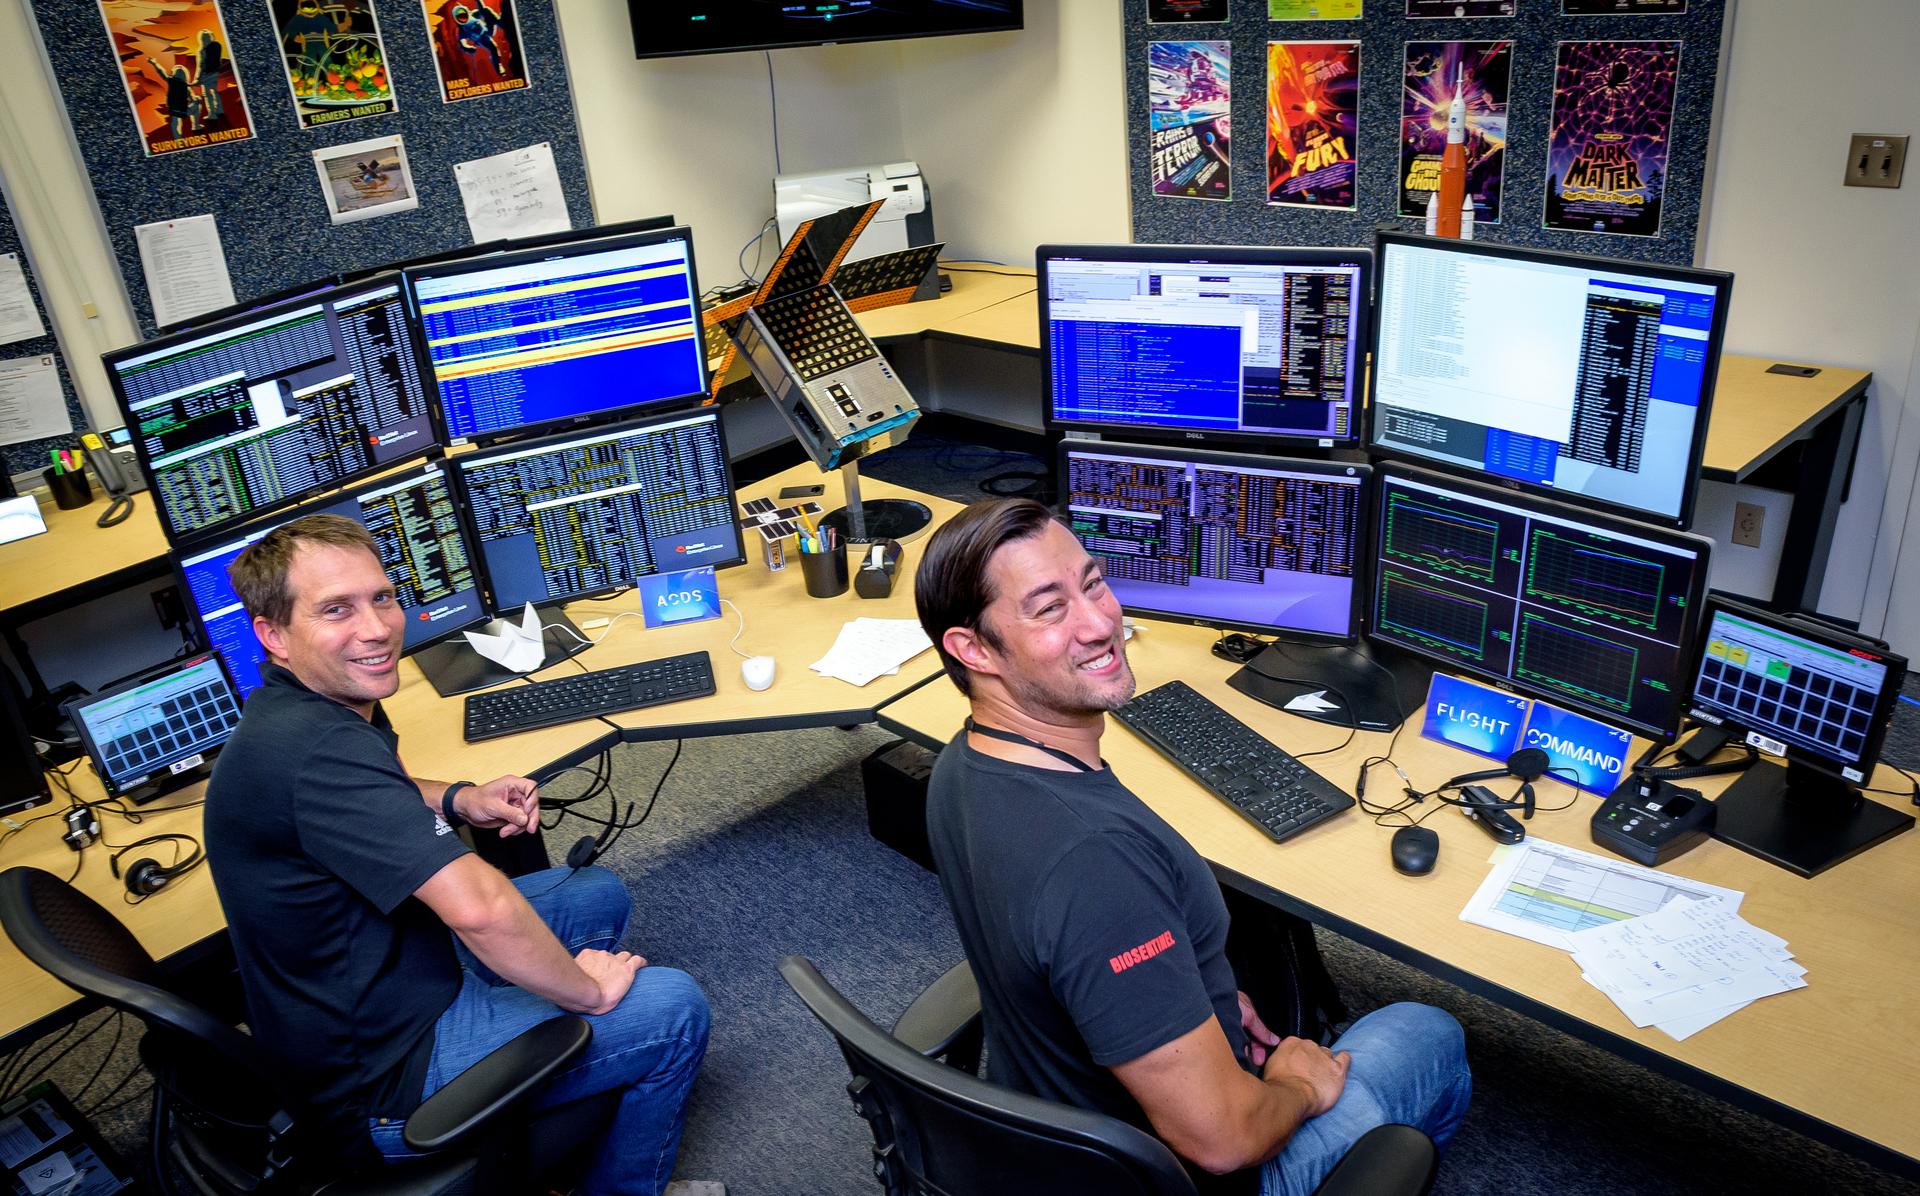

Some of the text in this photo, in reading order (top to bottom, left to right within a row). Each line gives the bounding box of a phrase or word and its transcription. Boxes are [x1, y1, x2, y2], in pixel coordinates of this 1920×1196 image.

[446, 78, 470, 90] MARS
[448, 78, 525, 100] EXPLORERS WANTED
[310, 102, 387, 125] FARMERS WANTED
[151, 127, 249, 153] SURVEYORS WANTED
[1291, 136, 1349, 178] FURY
[1583, 141, 1633, 165] DARK
[1562, 155, 1646, 193] MATTER
[1186, 432, 1205, 440] DELL
[657, 589, 703, 607] ACDS
[1496, 681, 1515, 692] DELL
[1436, 702, 1512, 737] FLIGHT
[1527, 728, 1622, 774] COMMAND
